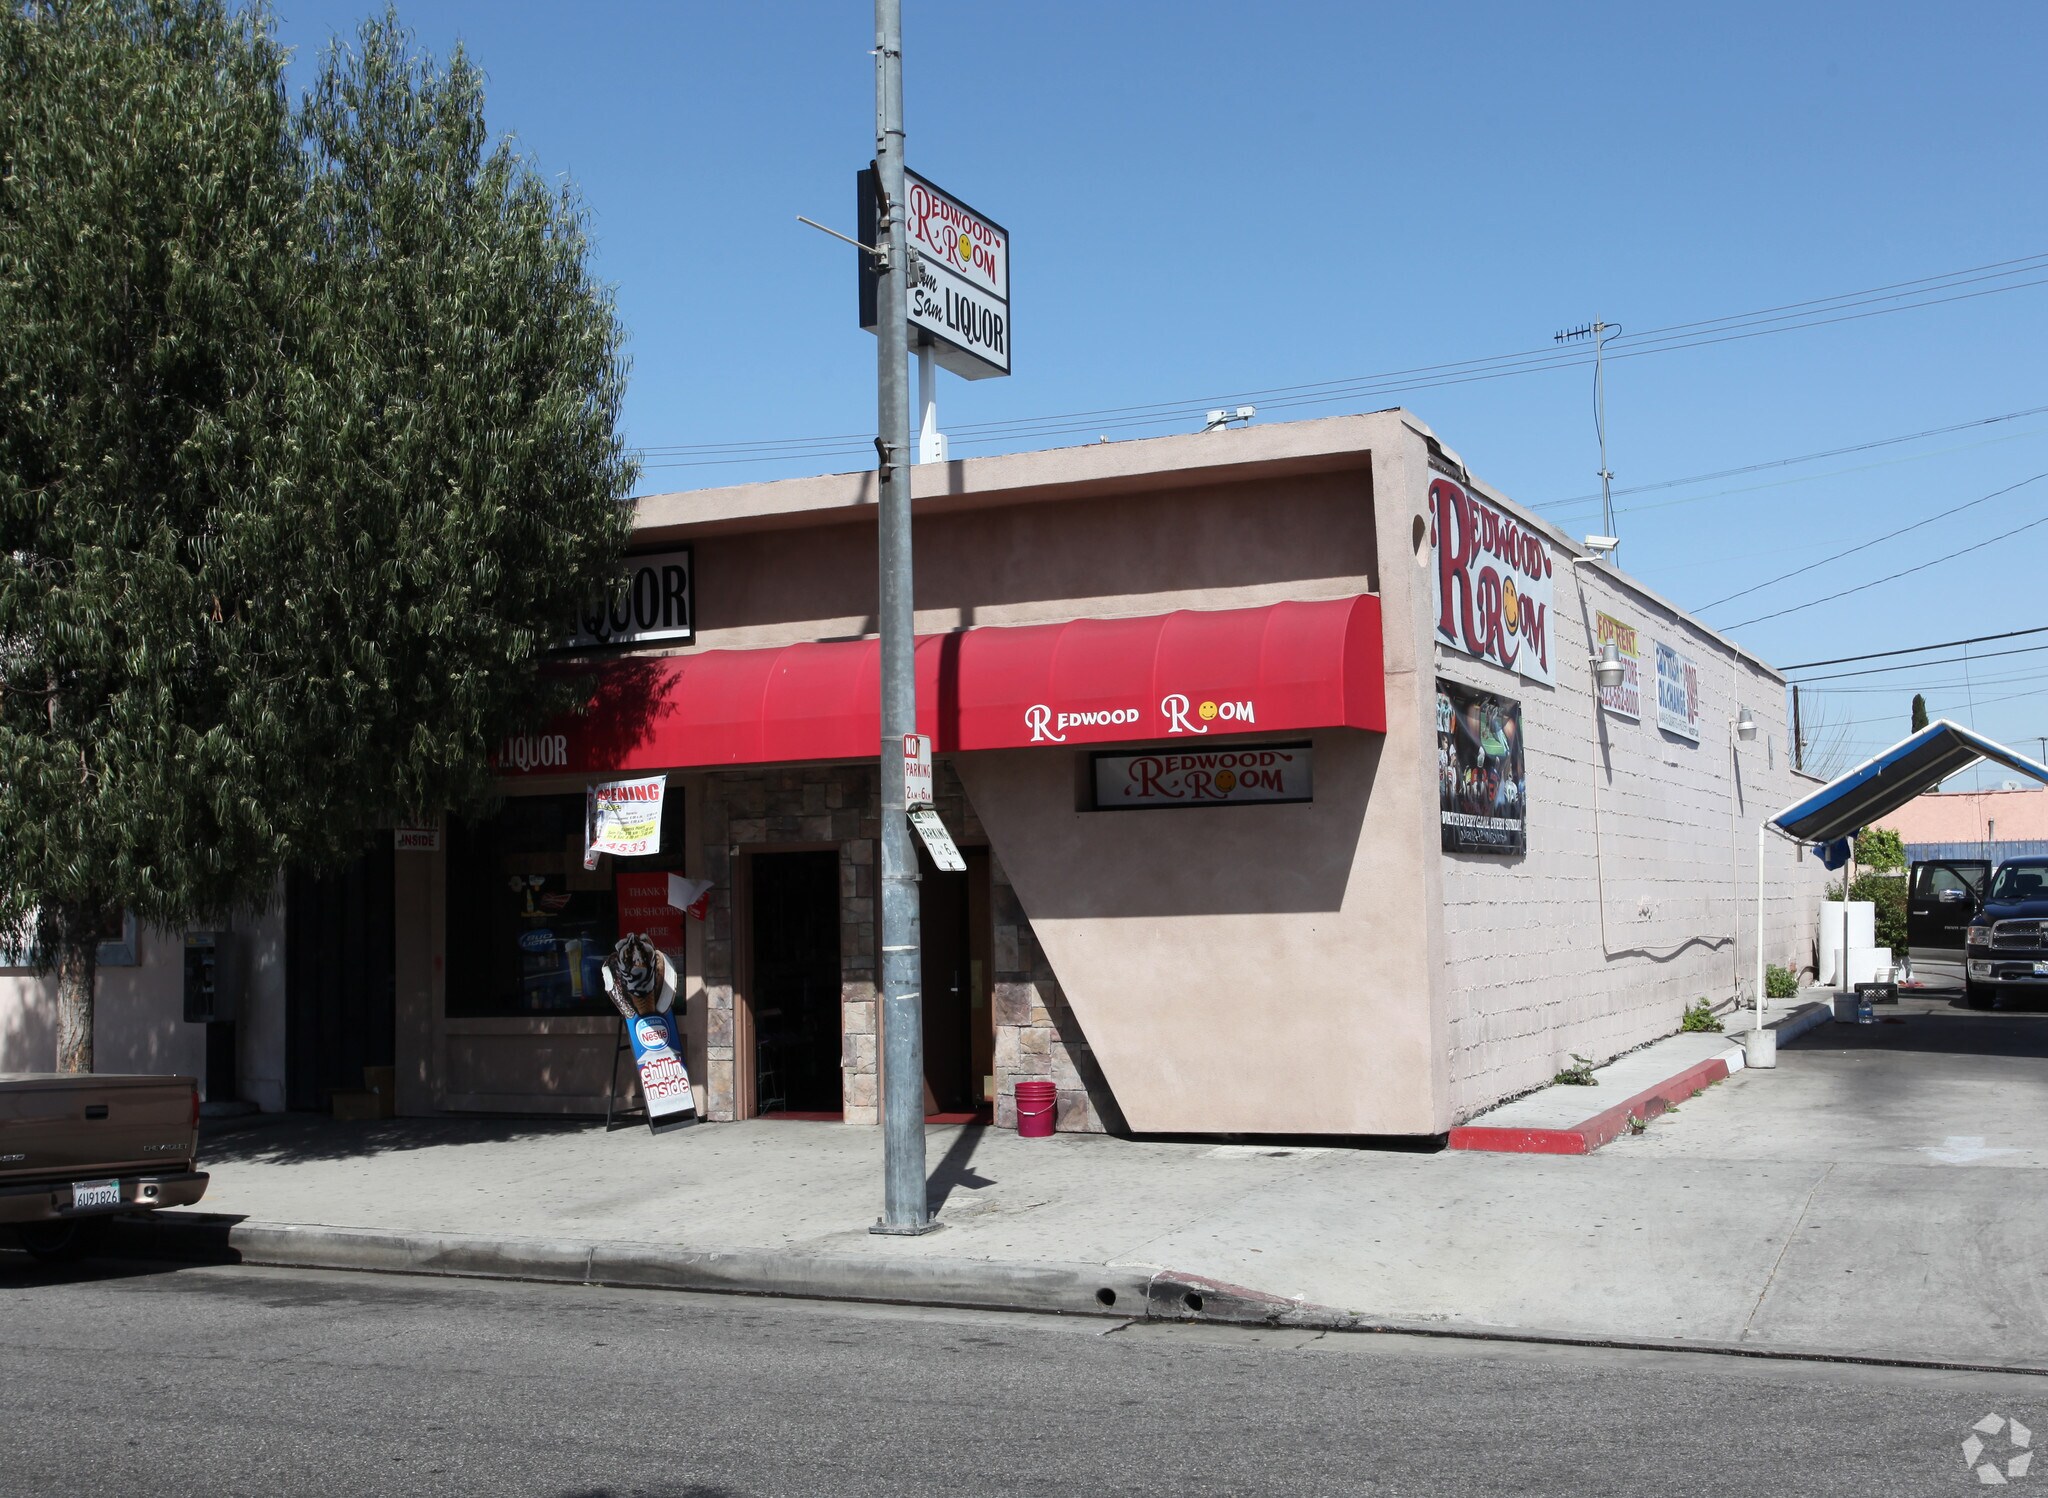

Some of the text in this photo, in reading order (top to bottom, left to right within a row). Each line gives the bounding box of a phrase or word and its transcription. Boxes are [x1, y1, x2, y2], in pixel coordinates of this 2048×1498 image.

[907, 184, 1000, 255] REDWOOD
[913, 287, 1004, 355] Sam LIQUOR
[1429, 478, 1552, 659] REDWOOD
[1597, 614, 1636, 656] FOR RENT
[1024, 704, 1140, 742] REDWOOD
[905, 737, 917, 755] NO
[905, 762, 931, 778] PARKING
[1124, 751, 1293, 798] REDWOOD
[597, 783, 660, 801] OPENING
[1460, 813, 1476, 828] EVERY
[1476, 815, 1490, 829] GAME
[1490, 816, 1505, 831] EVERY
[401, 834, 435, 847] INSIDE
[920, 827, 949, 840] PARKING
[628, 888, 659, 896] THANK
[624, 907, 641, 917] FOR
[526, 933, 553, 941] BUD
[646, 927, 669, 936] HERE
[523, 938, 555, 948] LIGHT
[640, 1056, 683, 1082] chillin
[643, 1075, 690, 1102] inside
[143, 1143, 188, 1152] CHEVROLET
[77, 1189, 118, 1207] 6U91826
